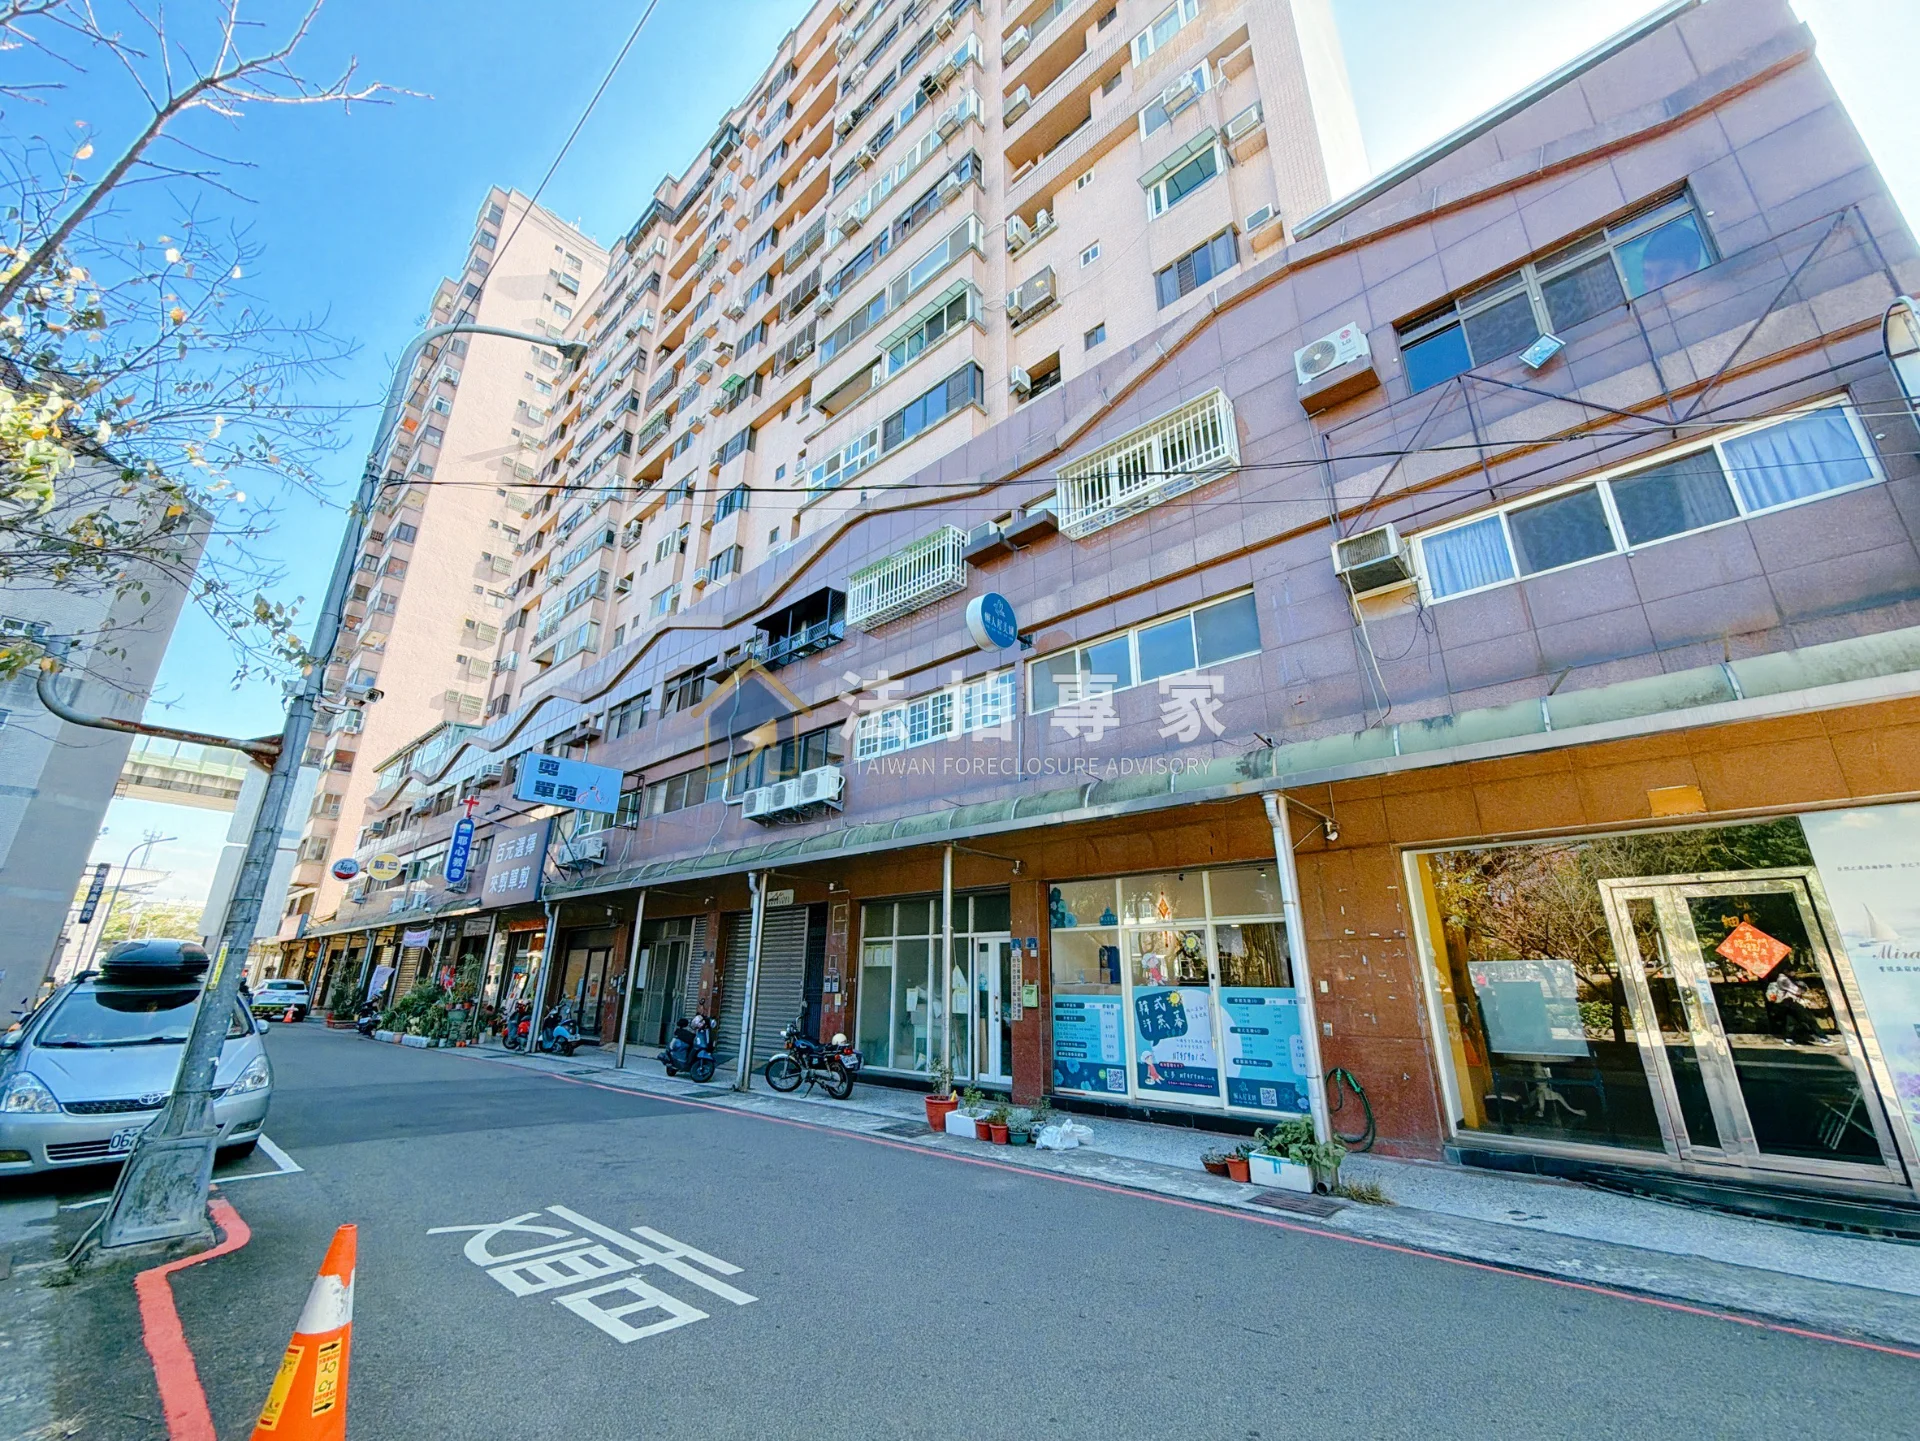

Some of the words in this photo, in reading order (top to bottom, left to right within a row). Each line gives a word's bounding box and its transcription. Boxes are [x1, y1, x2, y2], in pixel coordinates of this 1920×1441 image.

[538, 758, 560, 776] 剪
[533, 780, 578, 802] 單剪
[496, 832, 537, 863] 百元選擇
[488, 865, 530, 894] 來剪單剪
